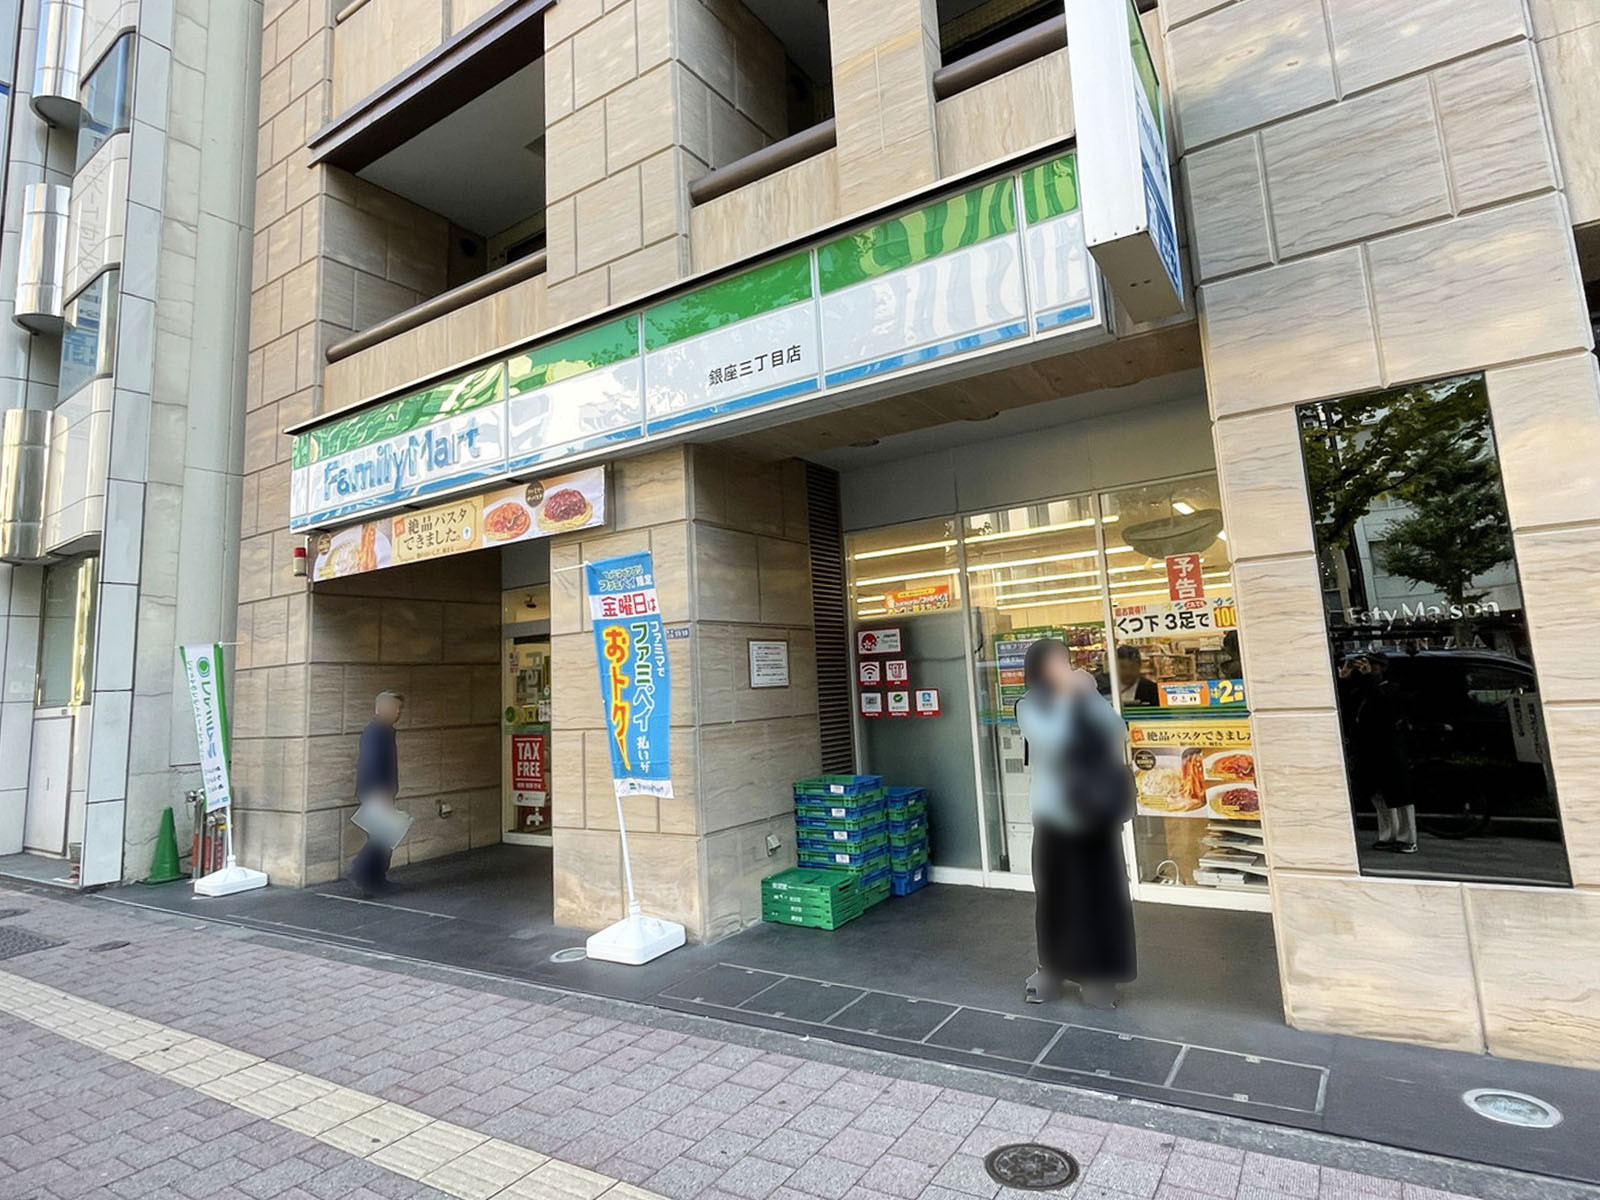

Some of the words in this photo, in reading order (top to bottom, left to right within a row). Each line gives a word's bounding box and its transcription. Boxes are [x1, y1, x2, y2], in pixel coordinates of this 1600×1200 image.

[708, 345, 801, 386] 銀座三丁目店
[323, 417, 481, 501] FamilyMart
[403, 527, 461, 551] できました。
[1173, 556, 1198, 599] 予告
[601, 592, 657, 618] 金曜日は
[1346, 605, 1398, 632] Esty
[1401, 600, 1501, 626] Maison
[649, 620, 666, 678] ファミマで
[630, 621, 656, 733] ファミペイ
[516, 742, 541, 761] TAX
[517, 761, 542, 777] FREE
